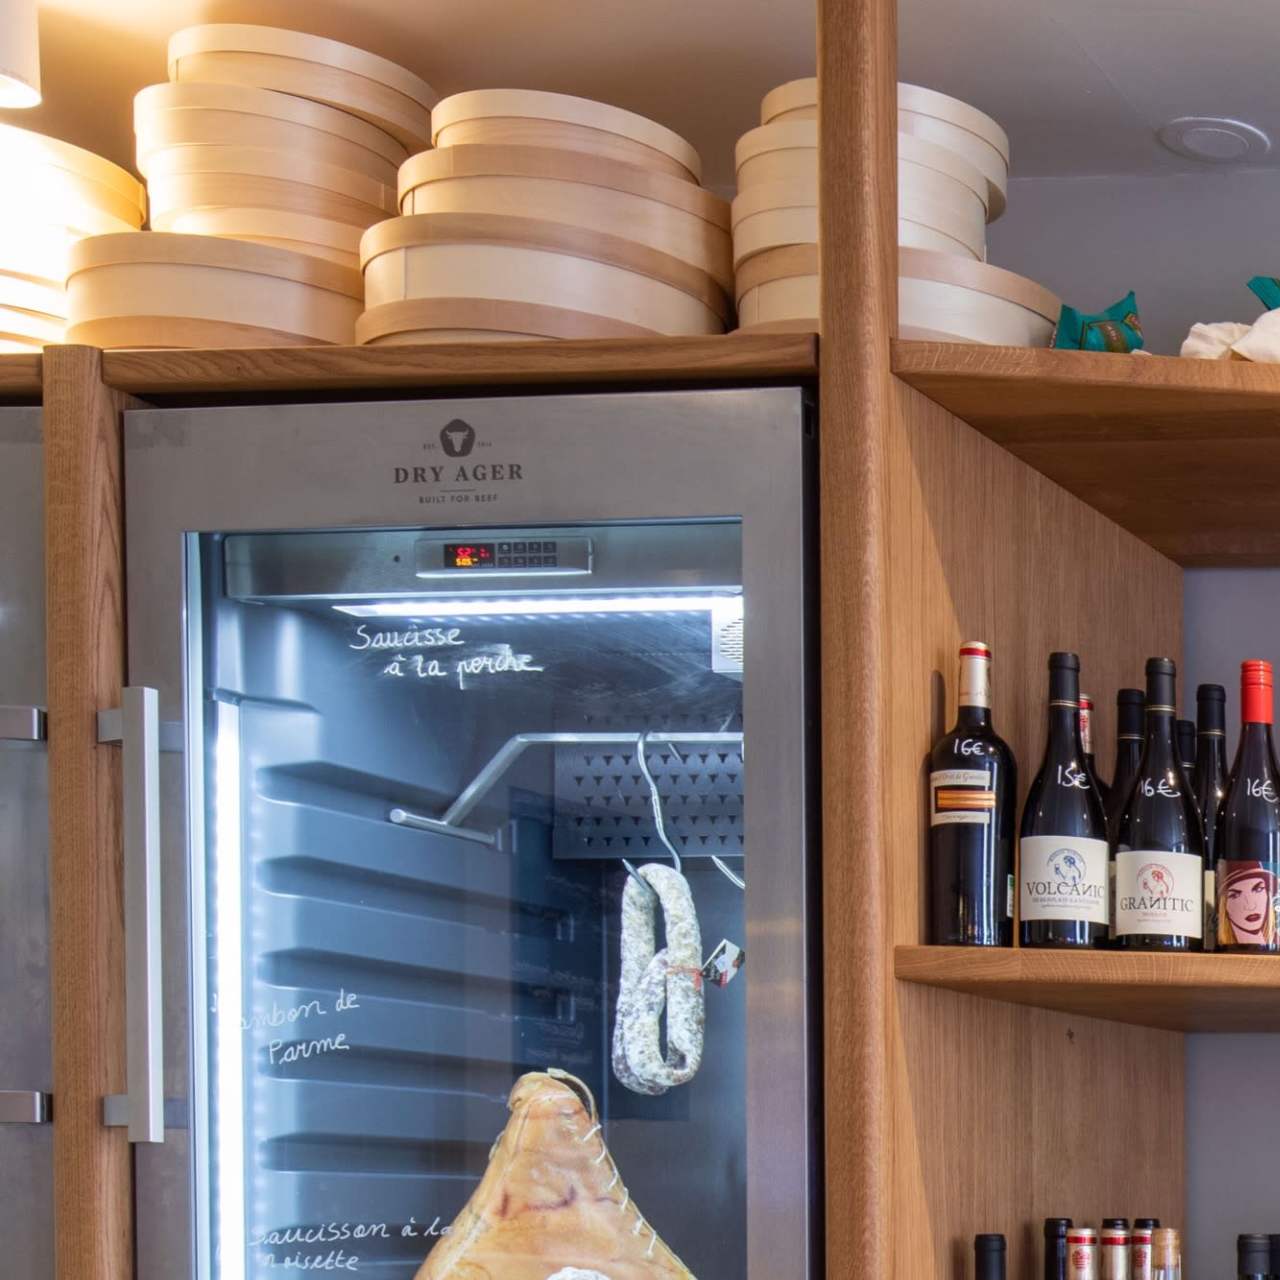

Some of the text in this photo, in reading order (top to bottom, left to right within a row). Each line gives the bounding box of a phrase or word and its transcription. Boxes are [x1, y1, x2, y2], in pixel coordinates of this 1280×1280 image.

[394, 463, 524, 484] DRY AGER
[419, 494, 499, 504] BUILT FOR BEEF
[384, 654, 405, 677] à
[415, 654, 447, 677] la
[954, 738, 986, 756] 16€
[1056, 765, 1091, 790] 15€
[1140, 777, 1181, 798] 16€
[1247, 778, 1280, 803] 16€
[1026, 879, 1105, 898] VOLCANIC
[1120, 896, 1194, 913] GRANITIC
[335, 988, 361, 1013] de
[267, 1033, 351, 1065] Parme
[401, 1217, 419, 1237] à
[261, 1250, 361, 1272] noisette
